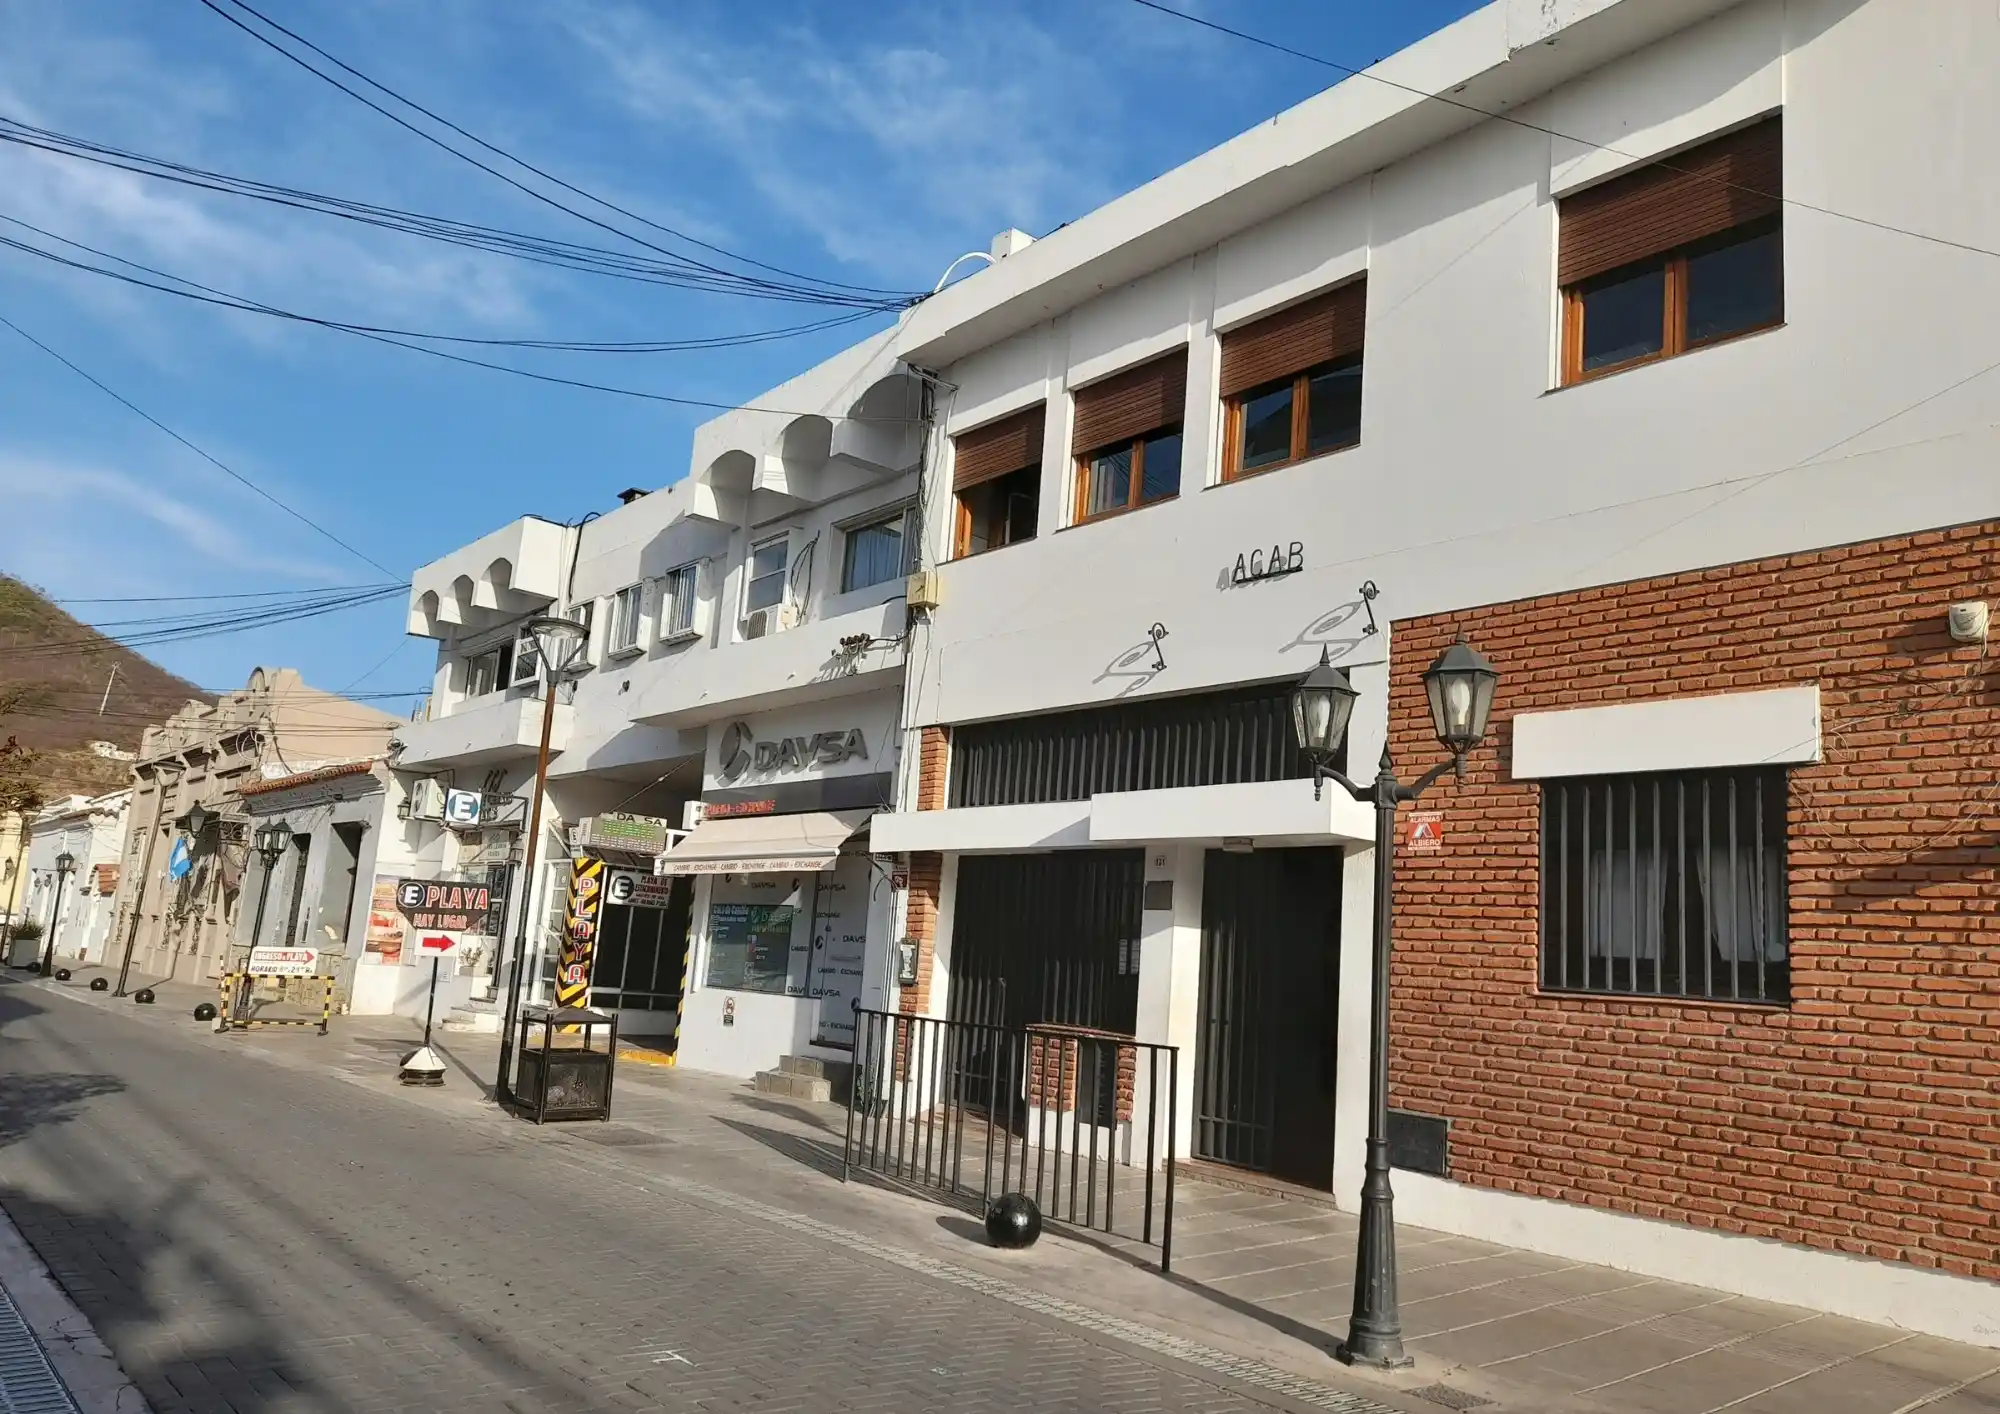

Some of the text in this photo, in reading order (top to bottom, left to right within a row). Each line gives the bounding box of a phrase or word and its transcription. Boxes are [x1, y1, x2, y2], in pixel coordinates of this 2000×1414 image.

[1231, 541, 1304, 583] ACAB
[754, 728, 868, 771] DAVSA
[454, 795, 475, 820] E
[1409, 839, 1441, 847] ALBIERO
[769, 861, 789, 869] CAMBIO
[794, 860, 822, 868] EXCHANGE
[613, 879, 630, 897] E
[403, 885, 488, 910] E PLAYA
[413, 913, 467, 929] HAY LUGAR
[566, 877, 596, 985] PLAYA
[250, 965, 277, 973] HORARIO
[812, 987, 841, 998] DAVSA
